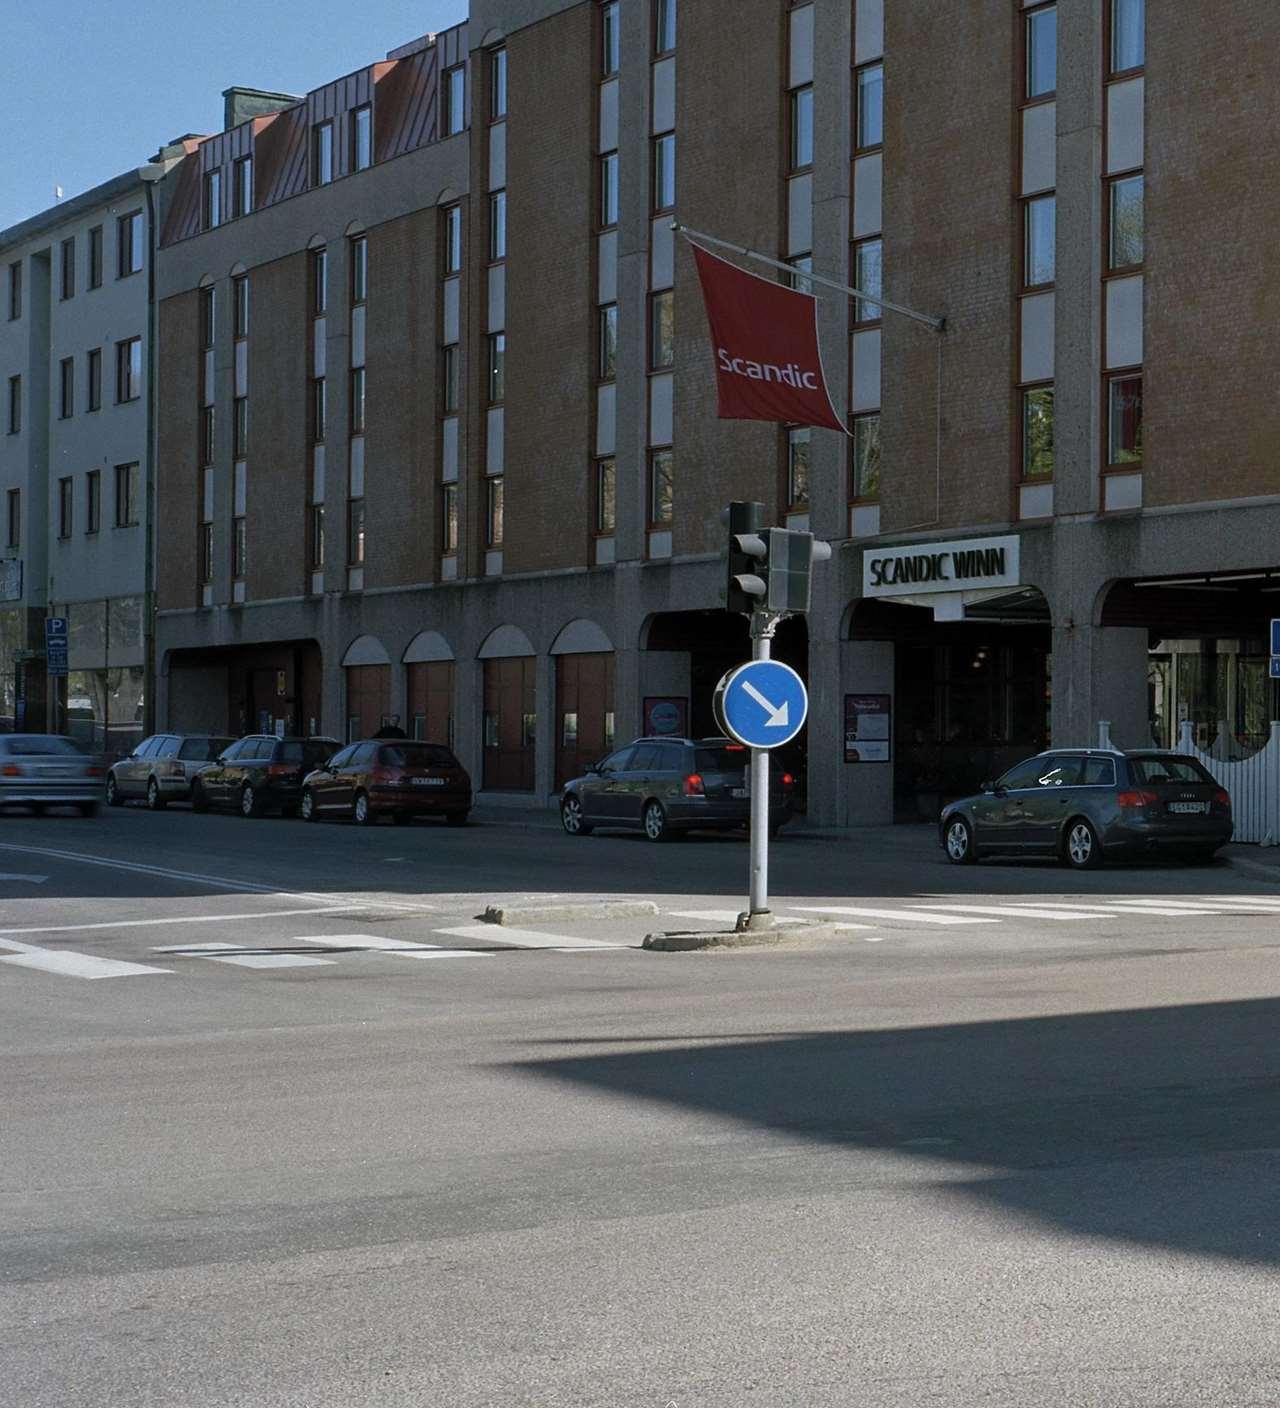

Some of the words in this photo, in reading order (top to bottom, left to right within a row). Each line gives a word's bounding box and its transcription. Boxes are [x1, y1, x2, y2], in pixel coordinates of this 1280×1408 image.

[718, 348, 818, 390] Scandic
[870, 552, 950, 586] SCANDIC
[952, 547, 1005, 579] WINN
[51, 619, 62, 633] P
